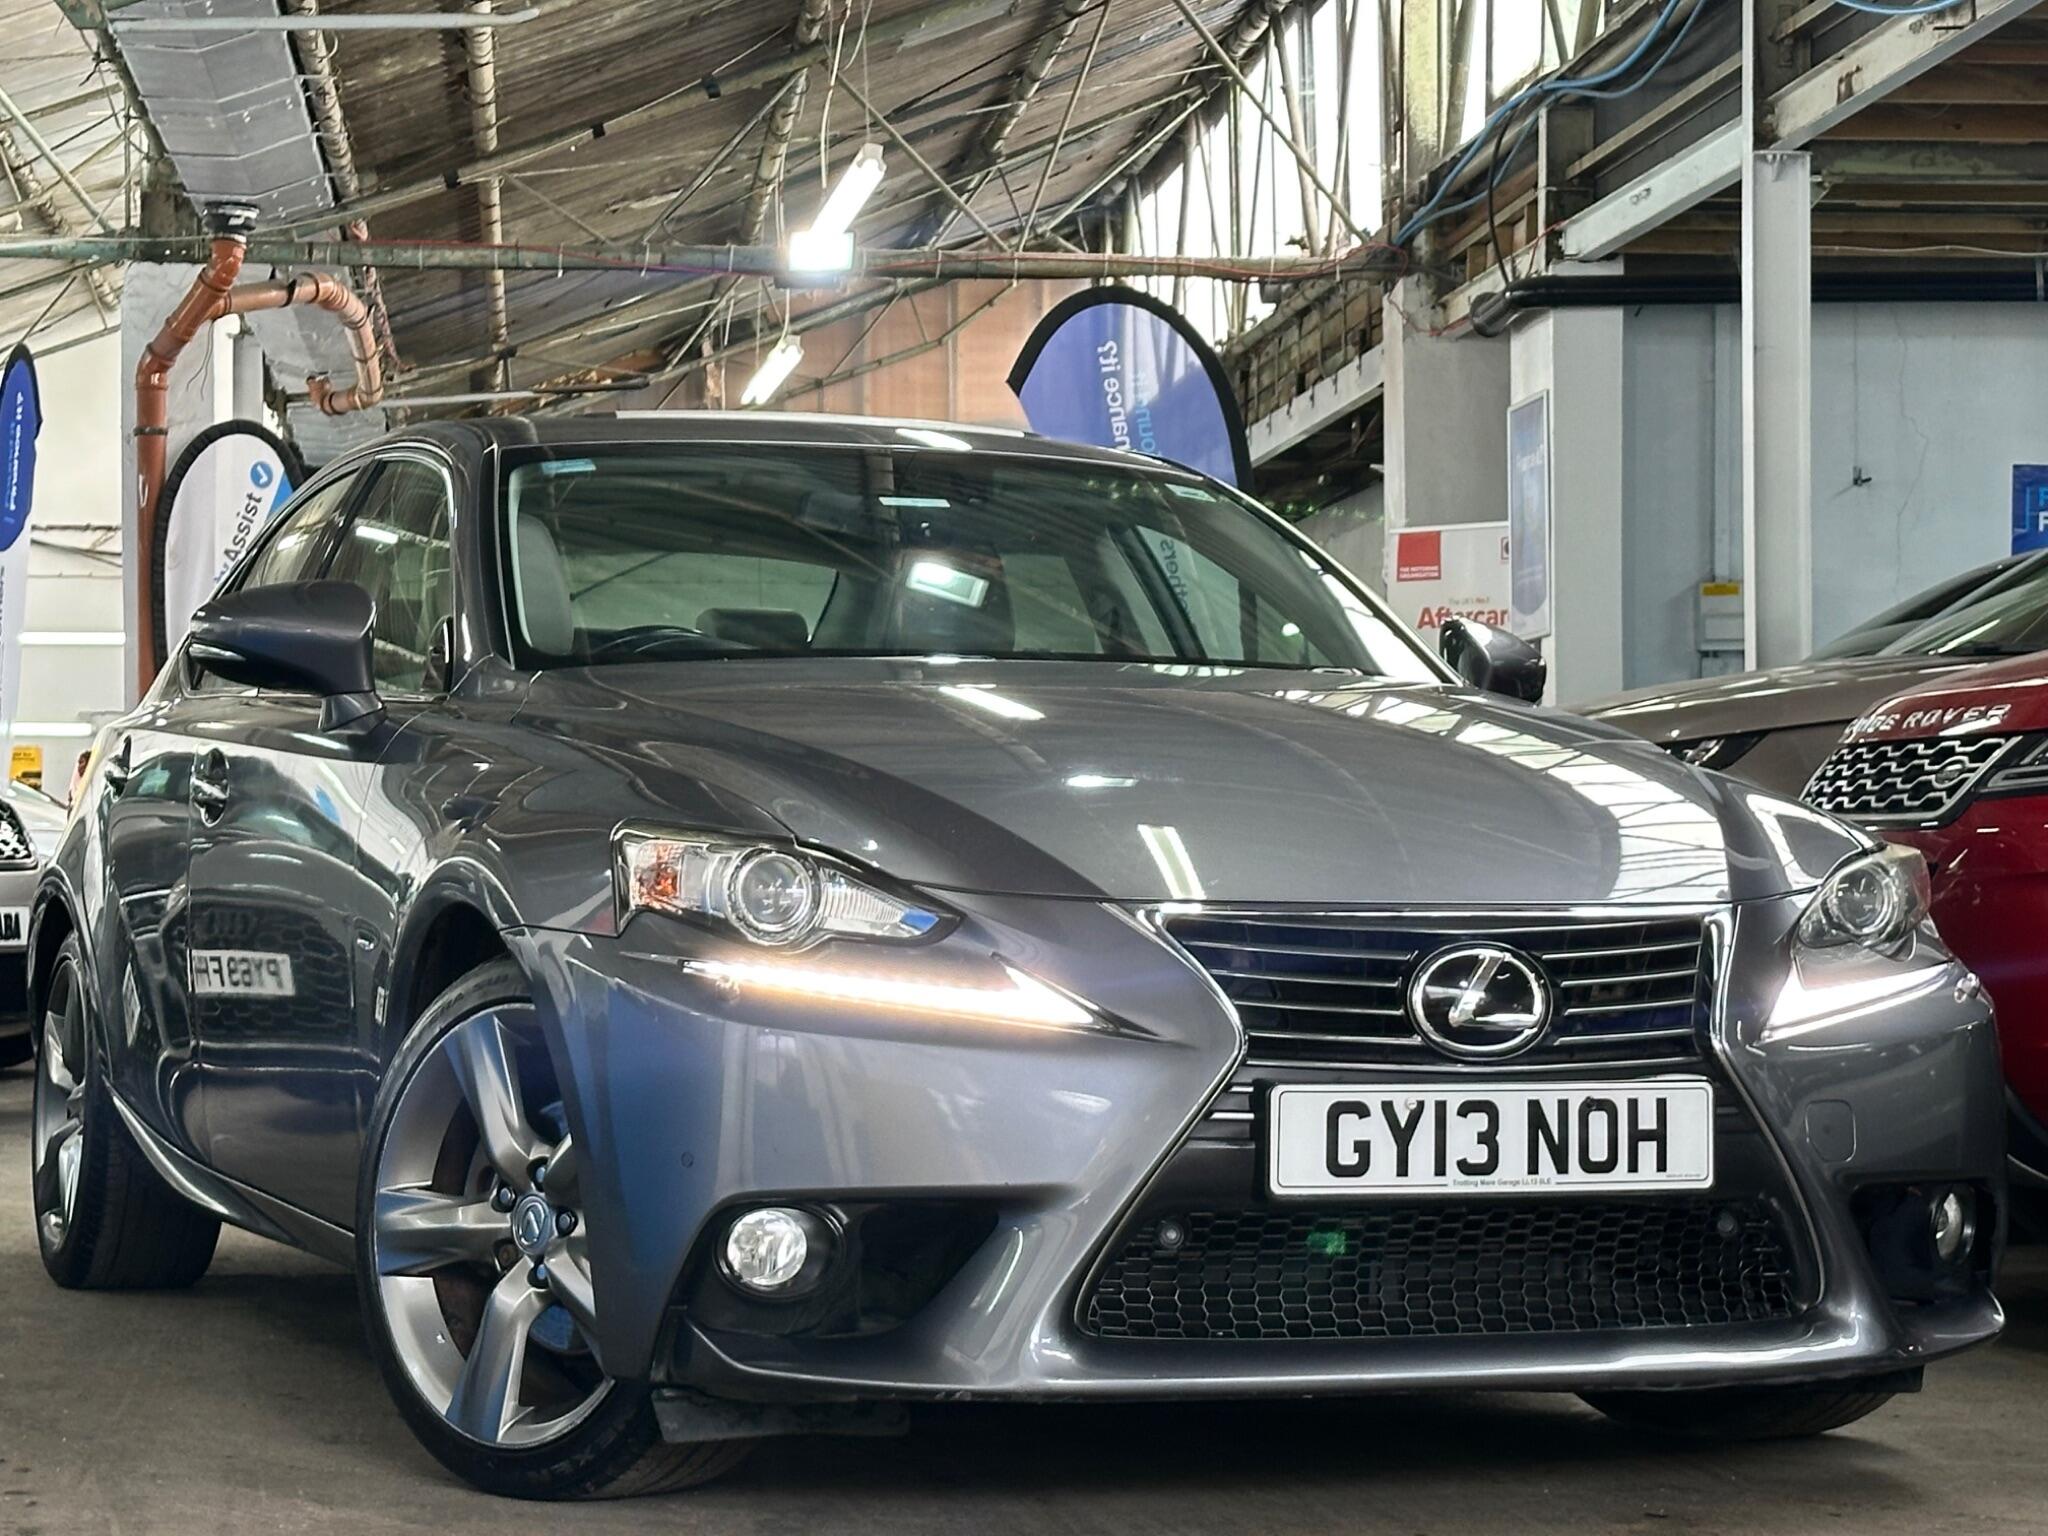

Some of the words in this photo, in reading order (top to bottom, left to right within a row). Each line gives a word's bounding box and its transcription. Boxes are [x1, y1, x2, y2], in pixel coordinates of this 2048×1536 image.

[223, 492, 263, 562] Assist
[1416, 606, 1509, 629] Afrcar
[1902, 703, 2012, 729] ROVER
[1326, 1099, 1500, 1178] GY13
[1527, 1096, 1668, 1176] NOH
